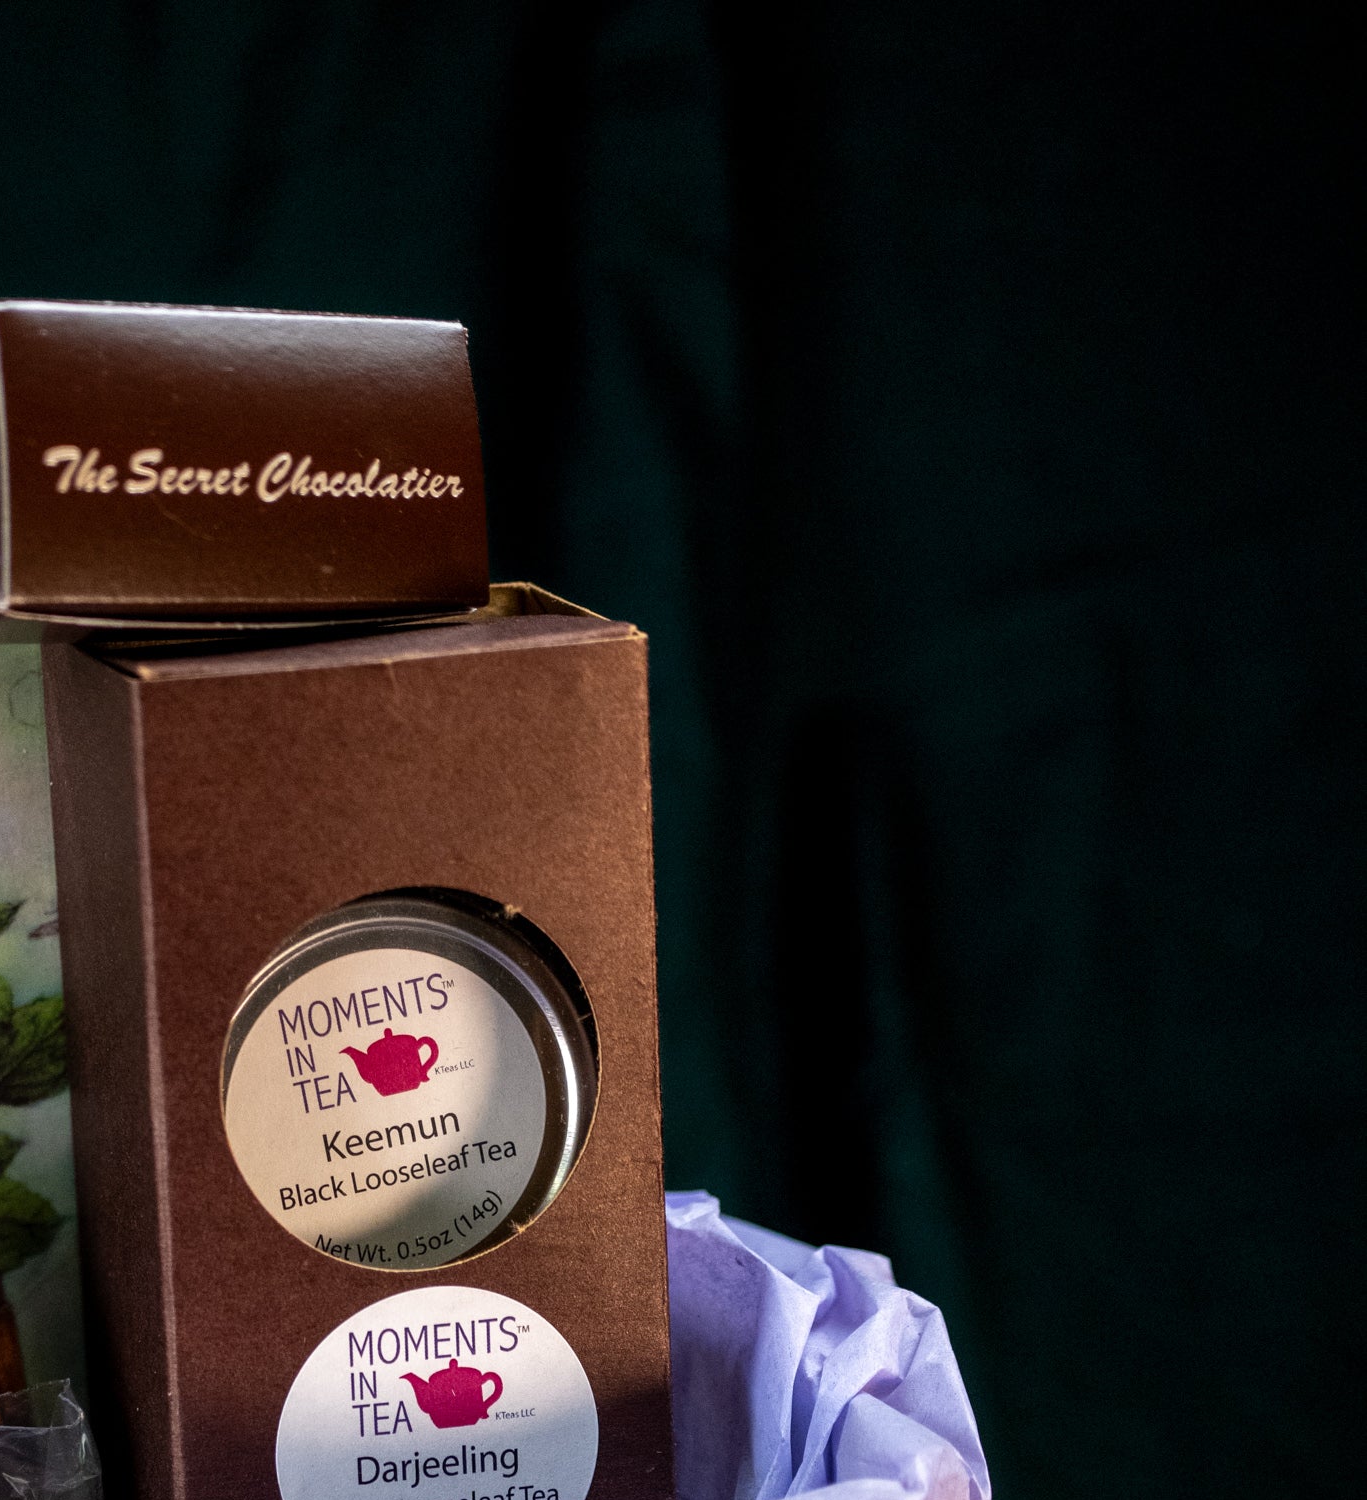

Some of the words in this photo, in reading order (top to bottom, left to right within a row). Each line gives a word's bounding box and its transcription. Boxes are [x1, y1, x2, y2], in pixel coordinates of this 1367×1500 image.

[43, 444, 119, 494] The
[125, 448, 251, 494] Secret
[256, 452, 465, 503] Chocolatier
[278, 973, 449, 1045] MOMENTS
[286, 1044, 316, 1077] IN
[434, 1063, 459, 1075] KTeas
[459, 1058, 476, 1071] LLC
[293, 1072, 357, 1114] TEA
[322, 1111, 461, 1163] Keemun
[279, 1176, 348, 1211] Black
[351, 1145, 469, 1194] Looseleaf
[473, 1140, 517, 1165] Tea
[315, 1234, 352, 1261] Net
[357, 1243, 392, 1263] Wt.
[397, 1230, 454, 1261] 0.5oz
[454, 1189, 504, 1239] (14g)
[348, 1316, 519, 1368] MOMENTS
[350, 1371, 377, 1401] IN
[352, 1401, 413, 1438] TEA
[495, 1409, 520, 1421] KTeas
[521, 1408, 536, 1418] LLC
[357, 1445, 519, 1488] Darjeeling
